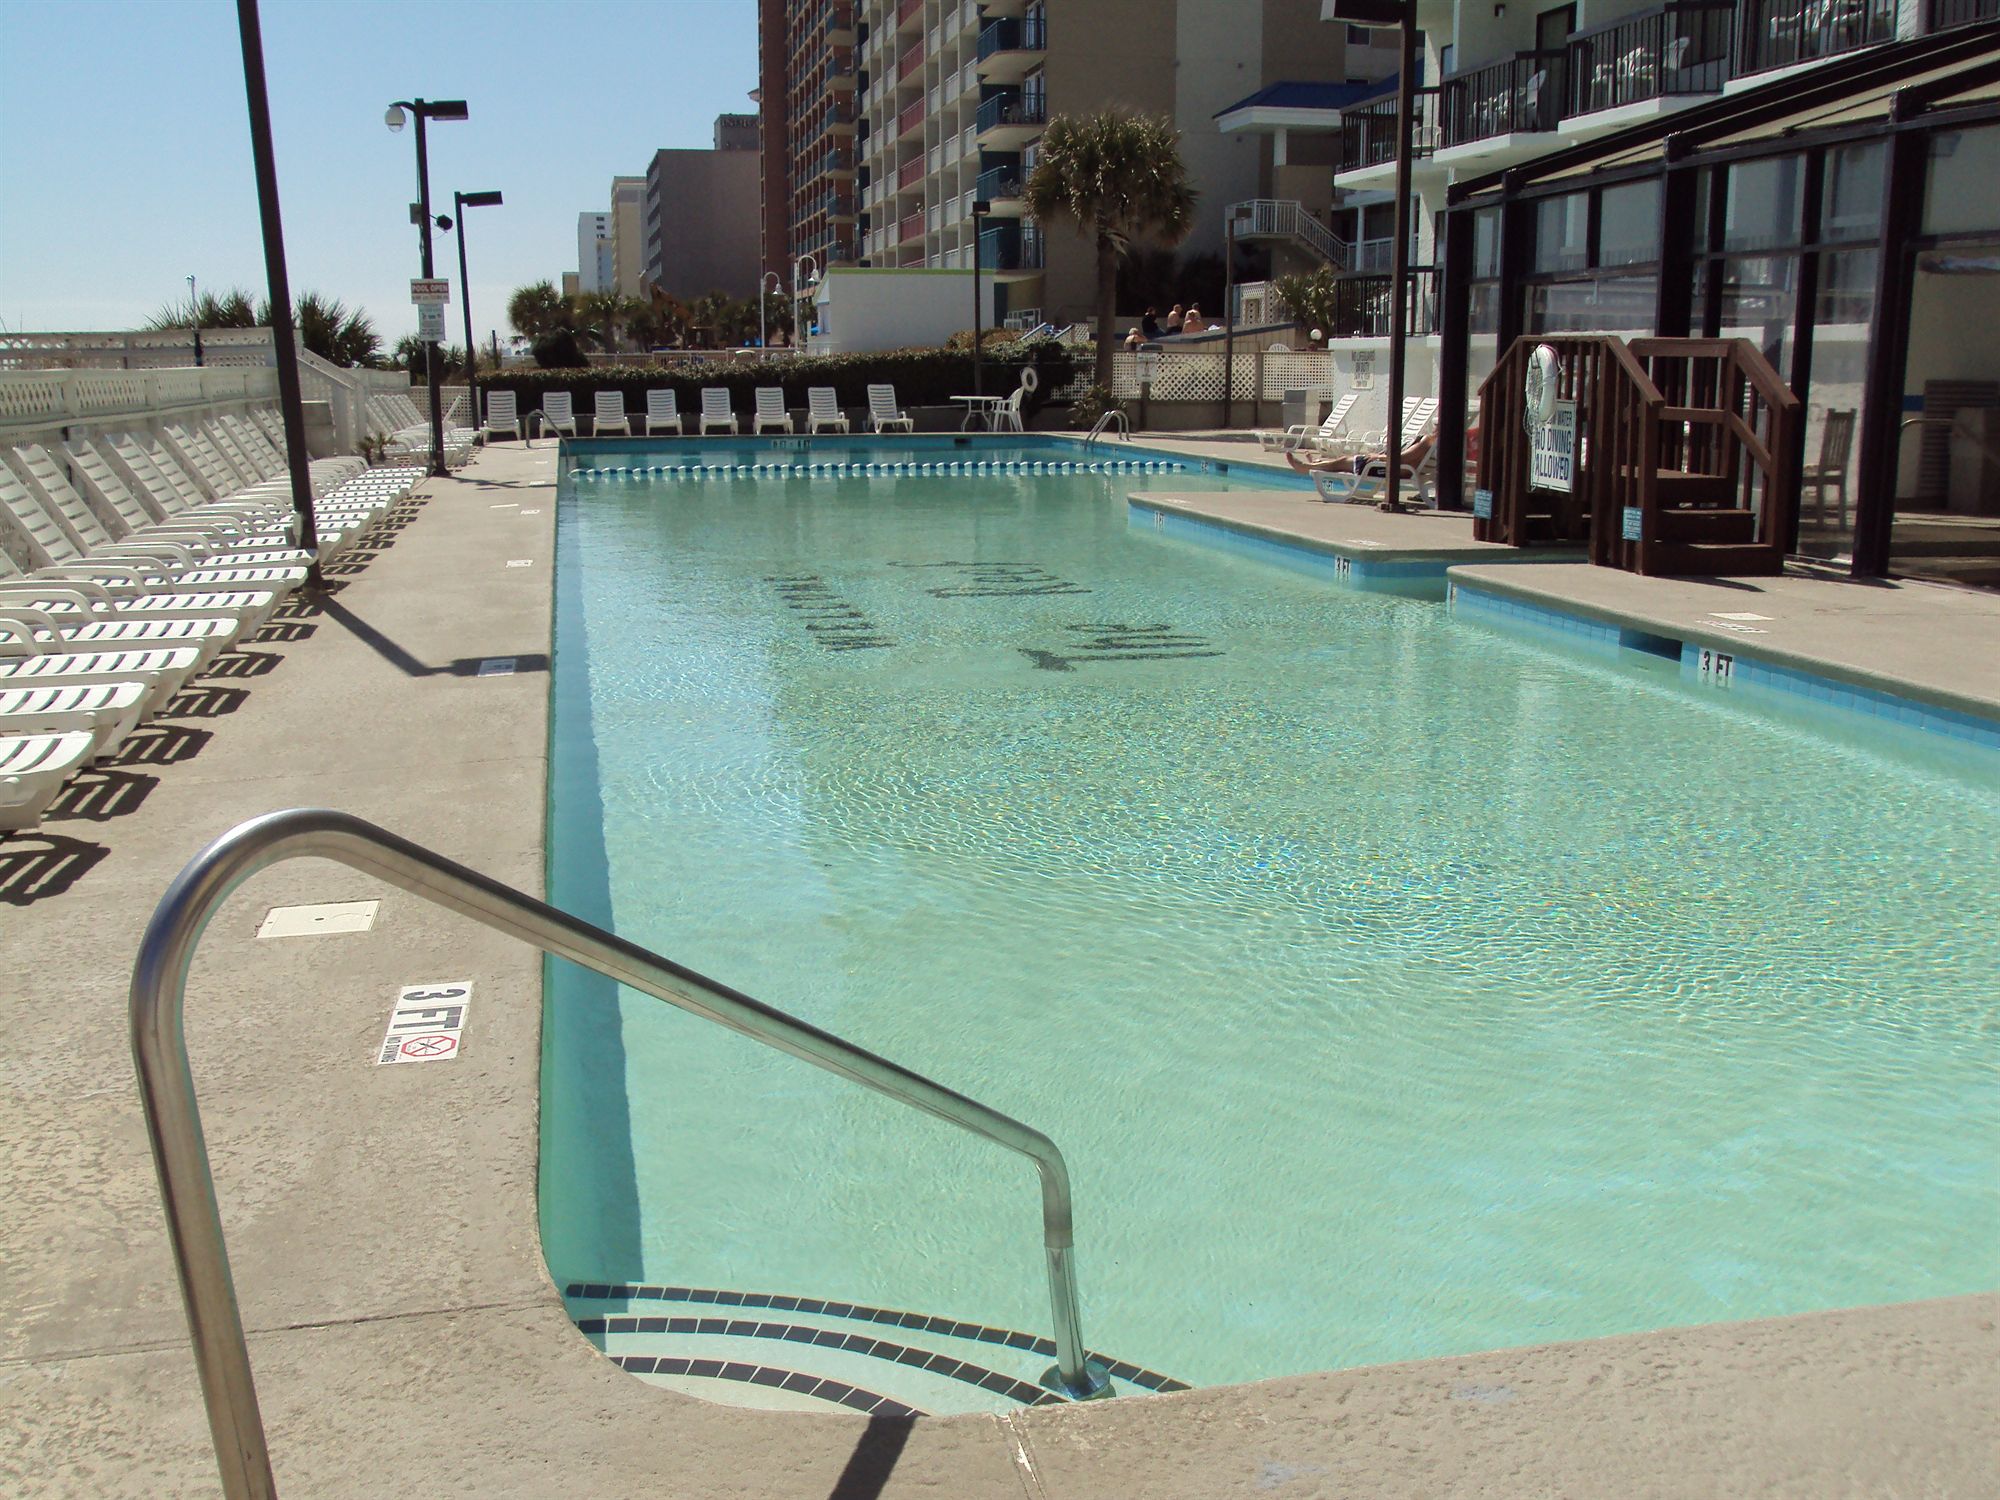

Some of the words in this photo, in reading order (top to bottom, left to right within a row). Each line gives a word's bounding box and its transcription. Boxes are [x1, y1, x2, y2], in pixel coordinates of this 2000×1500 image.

[411, 284, 430, 293] POOL
[430, 284, 449, 293] OPEN
[1557, 409, 1573, 427] WATER
[1535, 427, 1546, 451] NO
[1547, 428, 1572, 455] DIVING
[1535, 453, 1570, 481] ALLOWED
[1342, 557, 1351, 574] FT
[887, 560, 1093, 600] Reef
[763, 575, 898, 652] WELCOME
[1016, 624, 1226, 673] The
[1702, 650, 1711, 672] 3
[1715, 653, 1733, 676] FT
[403, 988, 466, 1001] 3
[393, 1006, 463, 1029] FT
[387, 1036, 403, 1044] NO
[380, 1044, 400, 1063] DIVING
